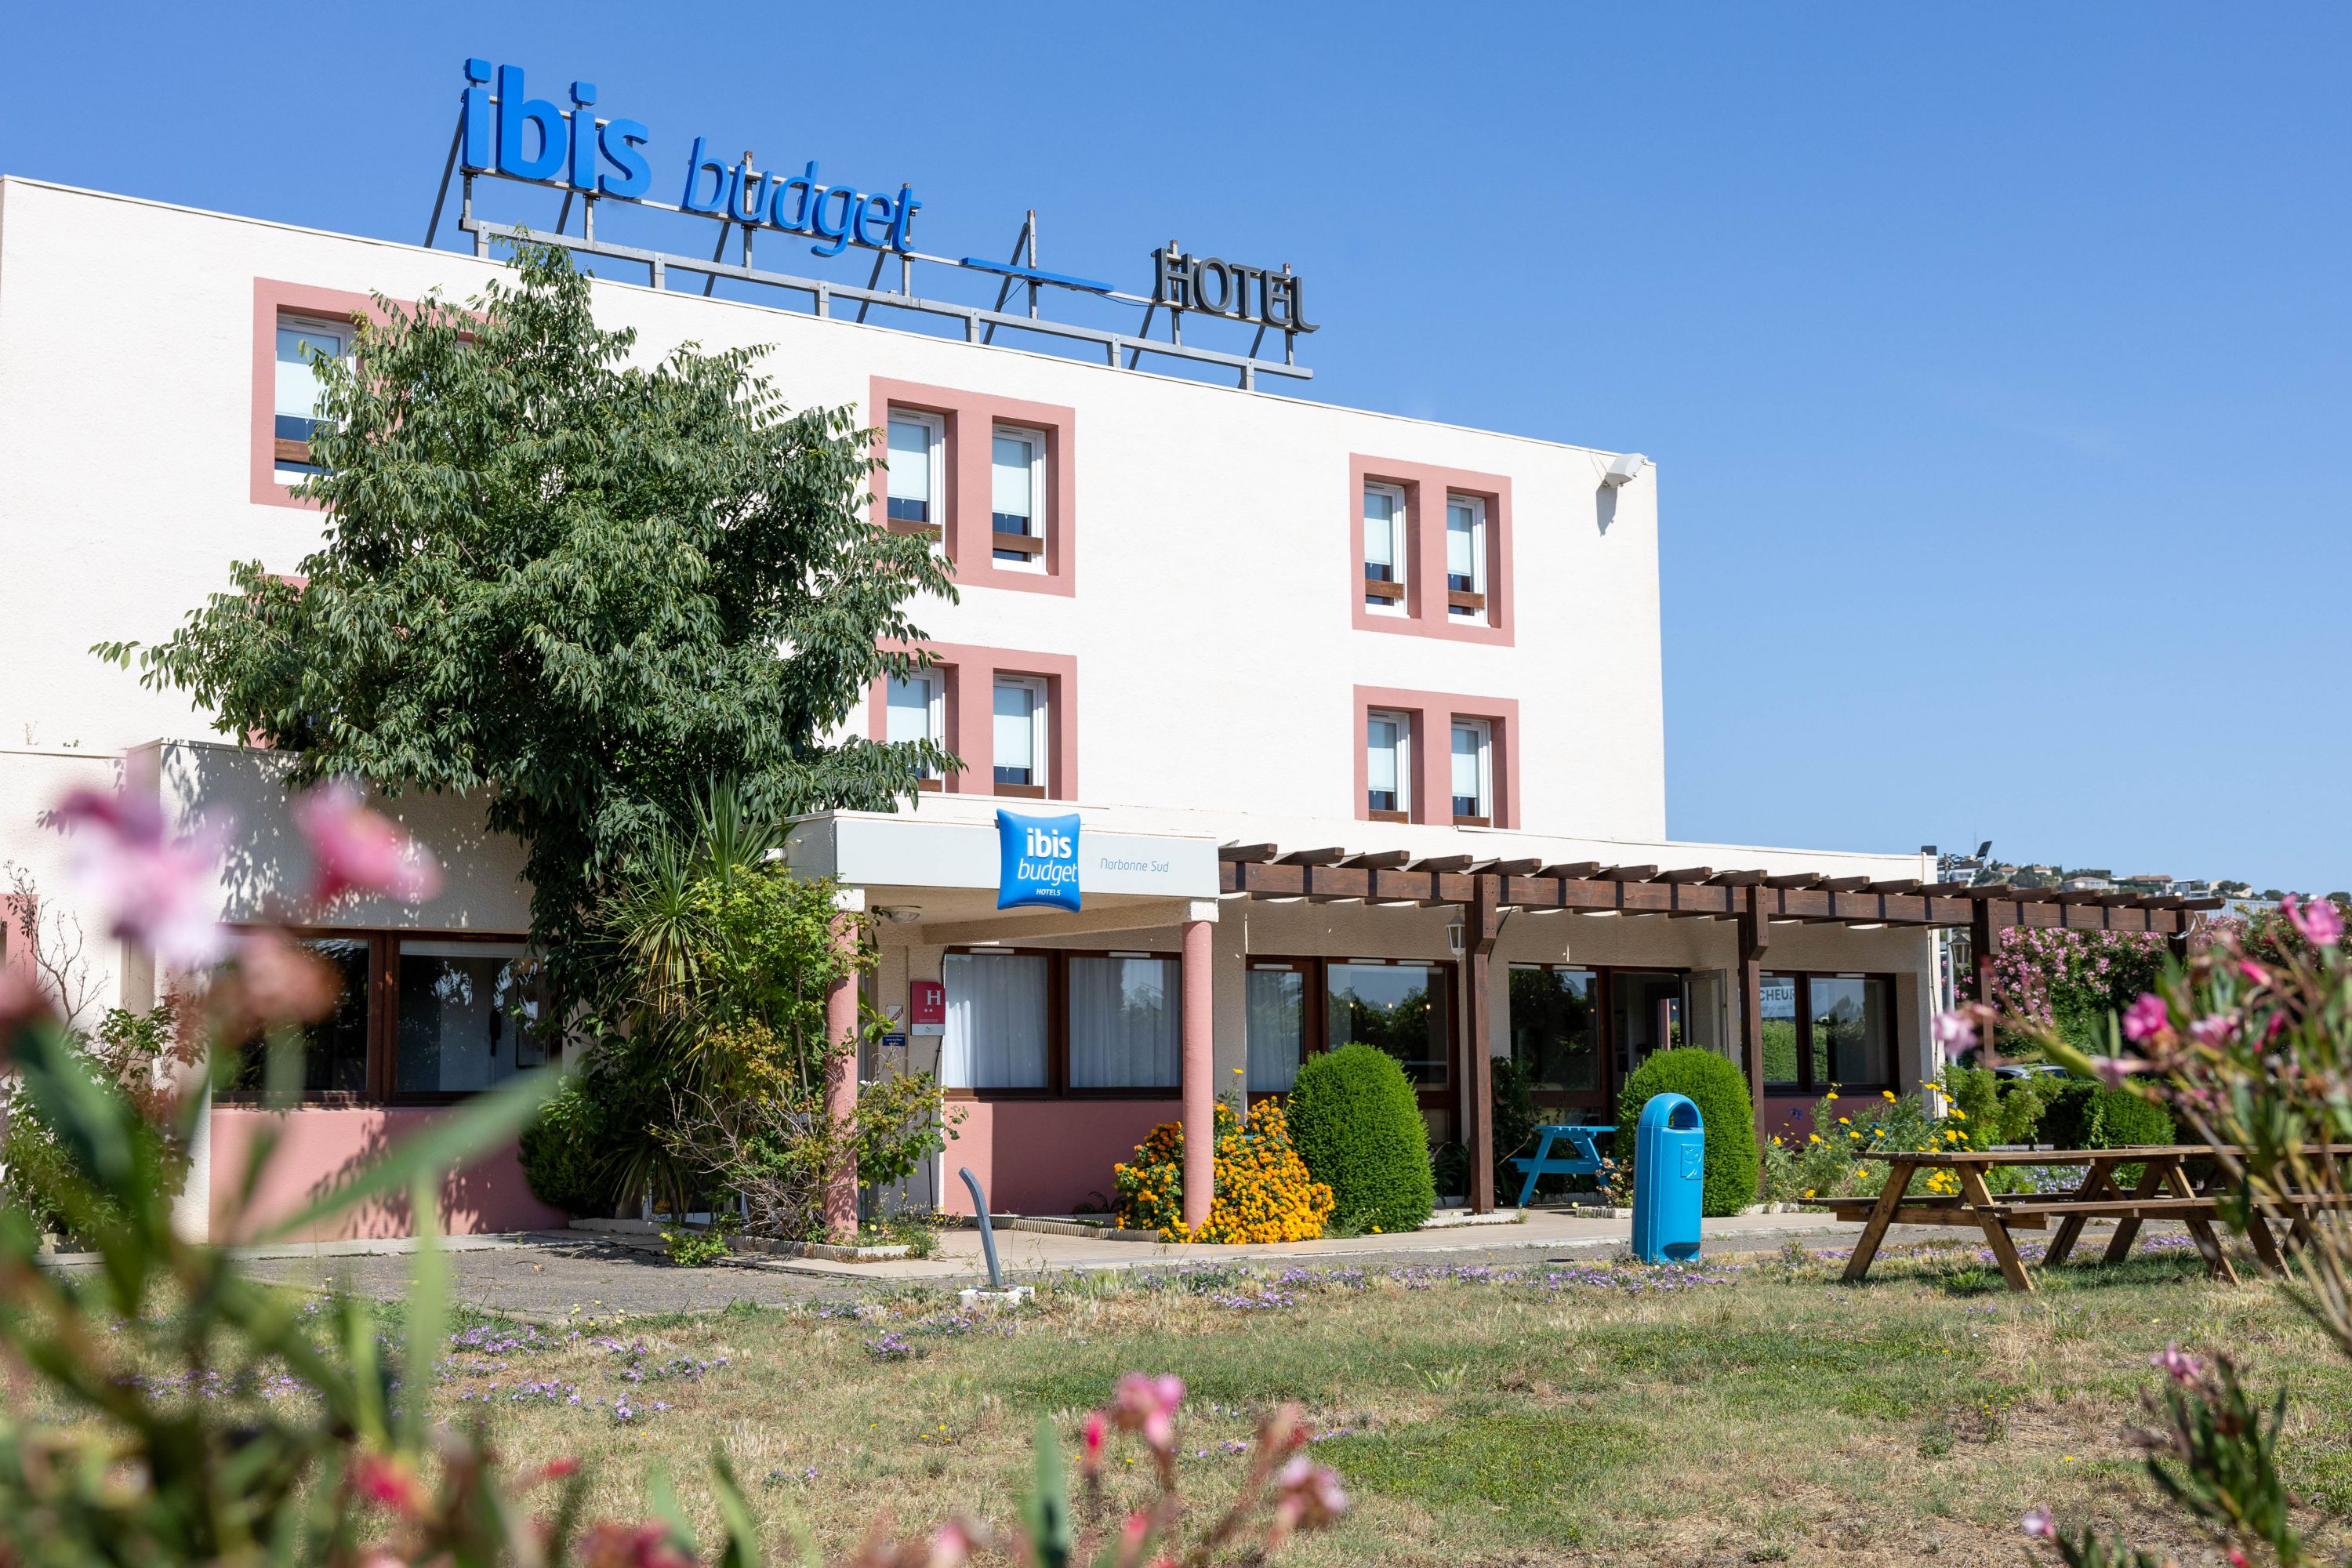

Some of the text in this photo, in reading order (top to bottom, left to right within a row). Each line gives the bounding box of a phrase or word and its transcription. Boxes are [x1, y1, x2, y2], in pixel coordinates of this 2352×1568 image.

[463, 57, 922, 257] ibis budget
[1154, 247, 1320, 334] HOTEL
[1026, 827, 1073, 860] ibis
[1017, 858, 1078, 886] budget
[1100, 858, 1170, 873] Narbonne Sud
[1036, 887, 1062, 897] HOTELS
[926, 989, 942, 1006] H
